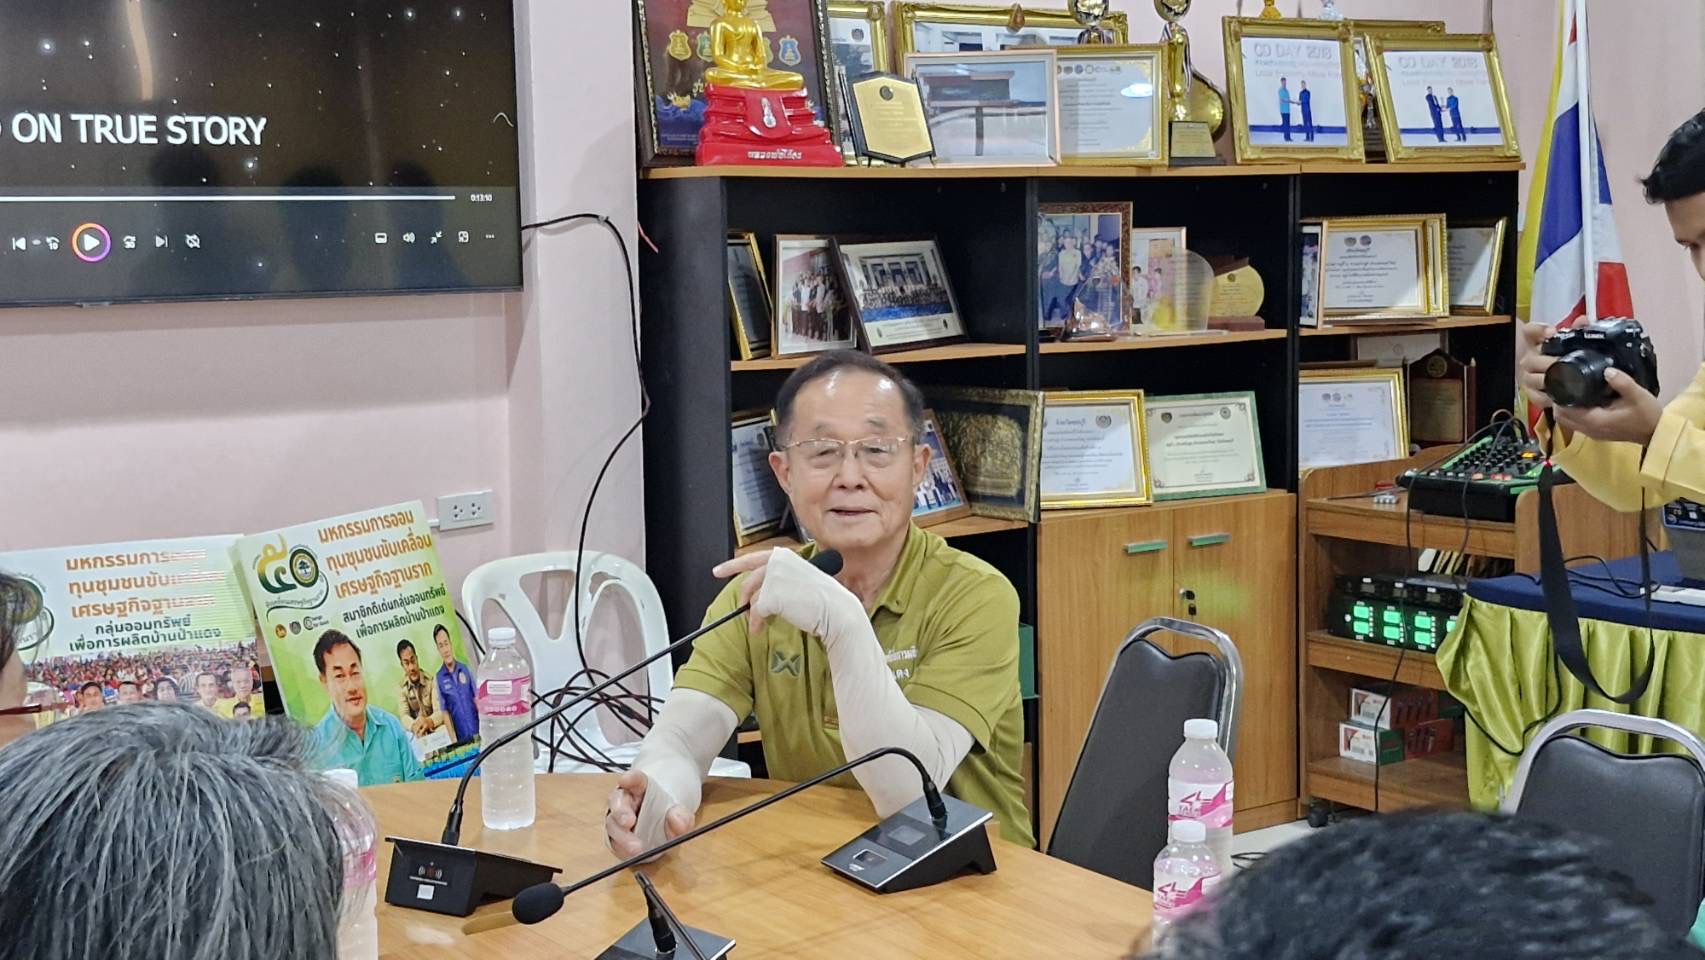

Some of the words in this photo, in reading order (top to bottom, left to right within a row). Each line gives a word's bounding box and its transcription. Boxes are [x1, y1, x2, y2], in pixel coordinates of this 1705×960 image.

[12, 112, 62, 143] ON
[70, 113, 158, 145] TRUE
[167, 114, 267, 146] STORY
[318, 510, 414, 543] มหกรรมการออม
[325, 527, 432, 575] ทุนชุมชนขับเคลื่อน
[335, 561, 433, 599] เศรษฐกิจฐานราก
